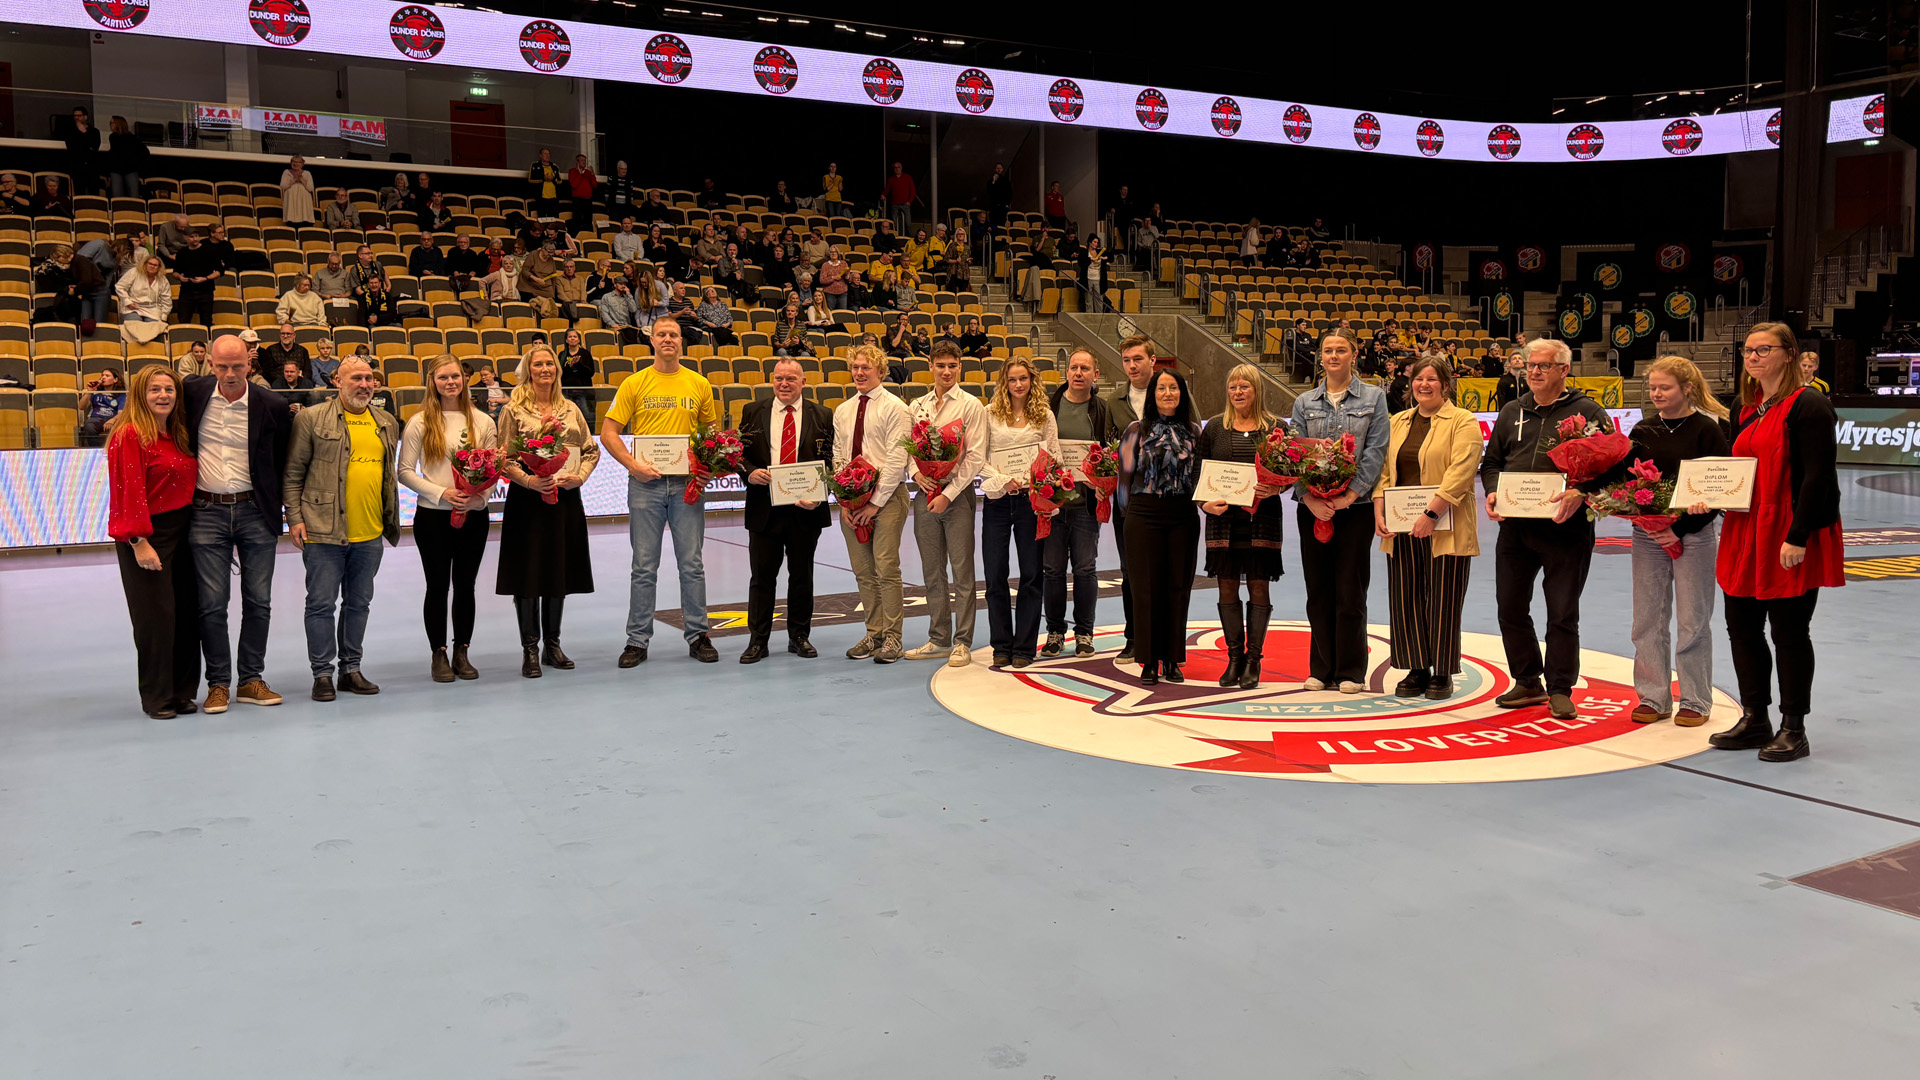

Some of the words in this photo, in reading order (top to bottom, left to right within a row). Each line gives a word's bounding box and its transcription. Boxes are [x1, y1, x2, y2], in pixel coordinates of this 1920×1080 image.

[100, 16, 135, 28] PARTILLE
[250, 10, 280, 21] DUNDER
[283, 12, 310, 24] DÖNER
[390, 25, 418, 36] DUNDER
[421, 28, 444, 39] DÖNER
[265, 32, 297, 45] PARTILLE
[405, 46, 432, 58] PARTILLE
[520, 40, 545, 49] DUNDER
[548, 42, 570, 52] DÖNER
[645, 52, 668, 62] DUNDER
[671, 54, 692, 64] DÖNER
[532, 59, 559, 71] PARTILLE
[754, 64, 776, 73] DUNDER
[778, 66, 798, 75] DÖNER
[656, 72, 681, 83] PARTILLE
[863, 76, 883, 84] DUNDER
[886, 78, 904, 86] DÖNER
[765, 82, 788, 93] PARTILLE
[956, 86, 975, 94] DUNDER
[978, 87, 994, 96] DÖNER
[1049, 95, 1066, 104] DUNDER
[1068, 96, 1083, 105] DÖNER
[1685, 132, 1703, 140] DÖNER
[1245, 704, 1356, 713] PIZZA
[1317, 694, 1631, 753] ILOVEPIZZA.SE
